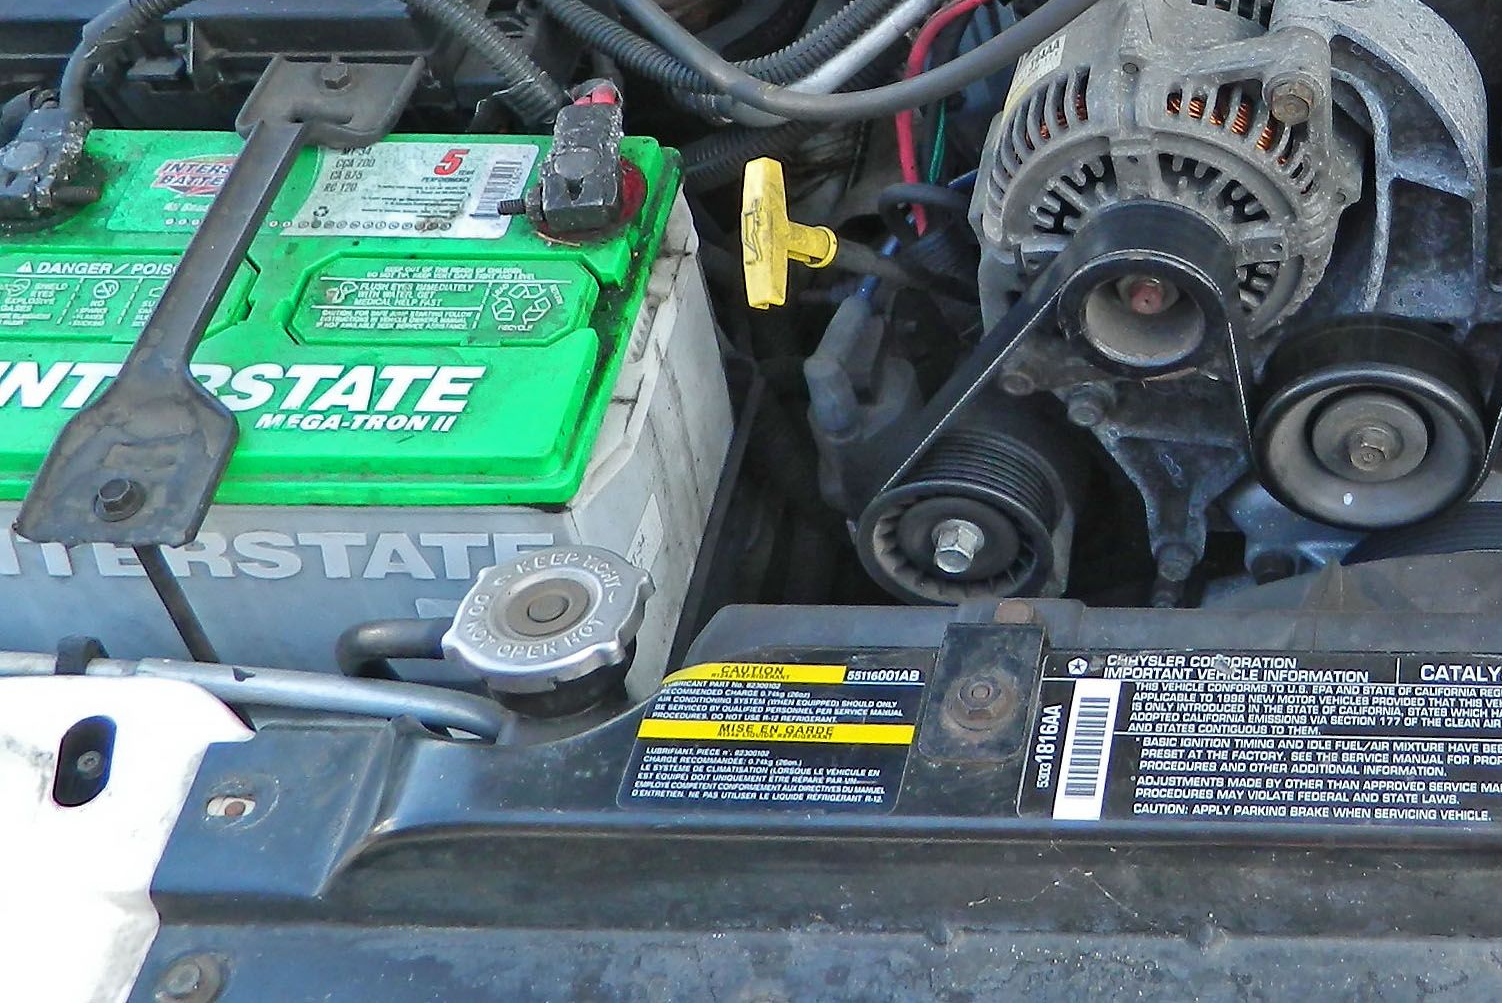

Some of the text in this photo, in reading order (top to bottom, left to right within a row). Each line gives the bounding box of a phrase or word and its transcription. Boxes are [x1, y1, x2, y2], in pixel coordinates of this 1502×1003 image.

[434, 149, 470, 176] 5
[37, 263, 113, 274] DANGER
[389, 283, 413, 291] EYES
[414, 283, 473, 292] IMMEDIATELY
[255, 412, 459, 433] MEGA-TRON II
[515, 552, 579, 574] KEEP
[497, 641, 557, 660] OPEN
[563, 619, 606, 648] HOT
[721, 666, 784, 675] CAUTION
[1103, 668, 1193, 680] IMPORTANT
[1260, 670, 1368, 683] INFORMATION
[1135, 682, 1158, 692] THIS
[1160, 683, 1204, 693] VEHICLE
[1206, 683, 1267, 694] CONFORMS
[1268, 684, 1284, 694] TO
[1286, 685, 1310, 694] U.S.
[1311, 685, 1333, 695] EPA
[1335, 685, 1360, 695] AND
[1361, 686, 1395, 696] STATE
[1397, 687, 1412, 696] OF
[1414, 687, 1477, 697] CALIFORNIA
[671, 697, 732, 705] CONDITIONING
[794, 699, 840, 707] EQUIPPED)
[874, 700, 897, 708] ONLY
[1133, 693, 1196, 703] APPLICABLE
[1196, 694, 1213, 703] TO
[1247, 695, 1274, 704] NEW
[1276, 696, 1316, 705] MOTOR
[1317, 696, 1369, 706] VEHICLES
[1371, 697, 1425, 707] PROVIDED
[1428, 698, 1455, 707] THAT
[1457, 698, 1483, 708] THIS
[719, 724, 835, 735] MISE EN GARDE
[1128, 724, 1321, 735] AND STATES CONTIGUOUS TO THEM.
[1143, 737, 1177, 748] BASIC
[1179, 738, 1230, 749] IGNITION
[1233, 739, 1274, 749] TIMING
[1277, 740, 1304, 750] AND
[1306, 740, 1331, 750] IDLE
[1334, 741, 1389, 751] FUEL/AIR
[1392, 742, 1444, 752] MIXTURE
[1447, 743, 1479, 753] HAVE
[1140, 761, 1447, 776] PROCEDURES AND OTHER ADDITIONAL INFORMATION.
[1137, 776, 1224, 788] ADJUSTMENTS
[1226, 777, 1262, 789] MADE
[1264, 778, 1281, 789] BY
[1284, 778, 1323, 790] OTHER
[1325, 779, 1362, 791] THAN
[1360, 780, 1426, 792] APPROVED
[1428, 781, 1479, 793] SERVICE
[1135, 789, 1459, 804] PROCEDURES MAY VIOLATE FEDERAL AND STATE LAWS.
[1134, 803, 1491, 821] CAUTION: APPLY PARKING BRAKE WHEN SERVICING VEHICLE.
